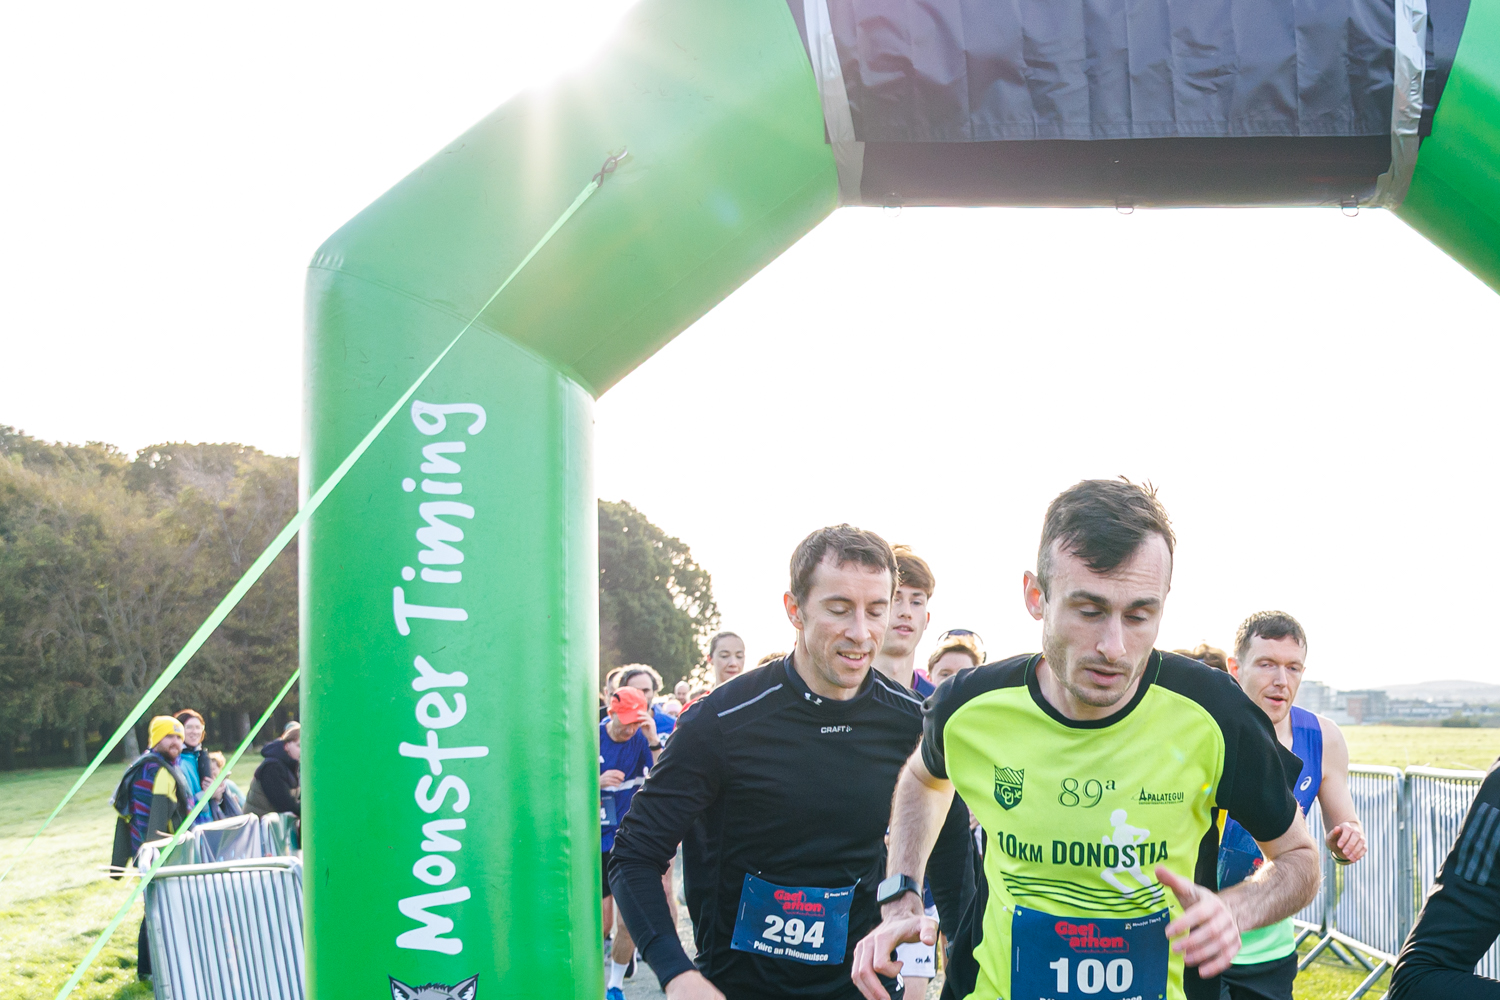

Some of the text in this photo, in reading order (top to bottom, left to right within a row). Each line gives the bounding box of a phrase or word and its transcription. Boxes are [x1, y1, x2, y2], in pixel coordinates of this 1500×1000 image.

[392, 399, 489, 955] Monster Timing
[820, 725, 846, 734] CRAFT
[1051, 840, 1169, 869] DONOSTIA
[762, 914, 825, 948] 294
[1054, 921, 1096, 937] Gael
[773, 947, 784, 955] an
[1069, 936, 1126, 949] athon
[1049, 957, 1134, 994] 100
